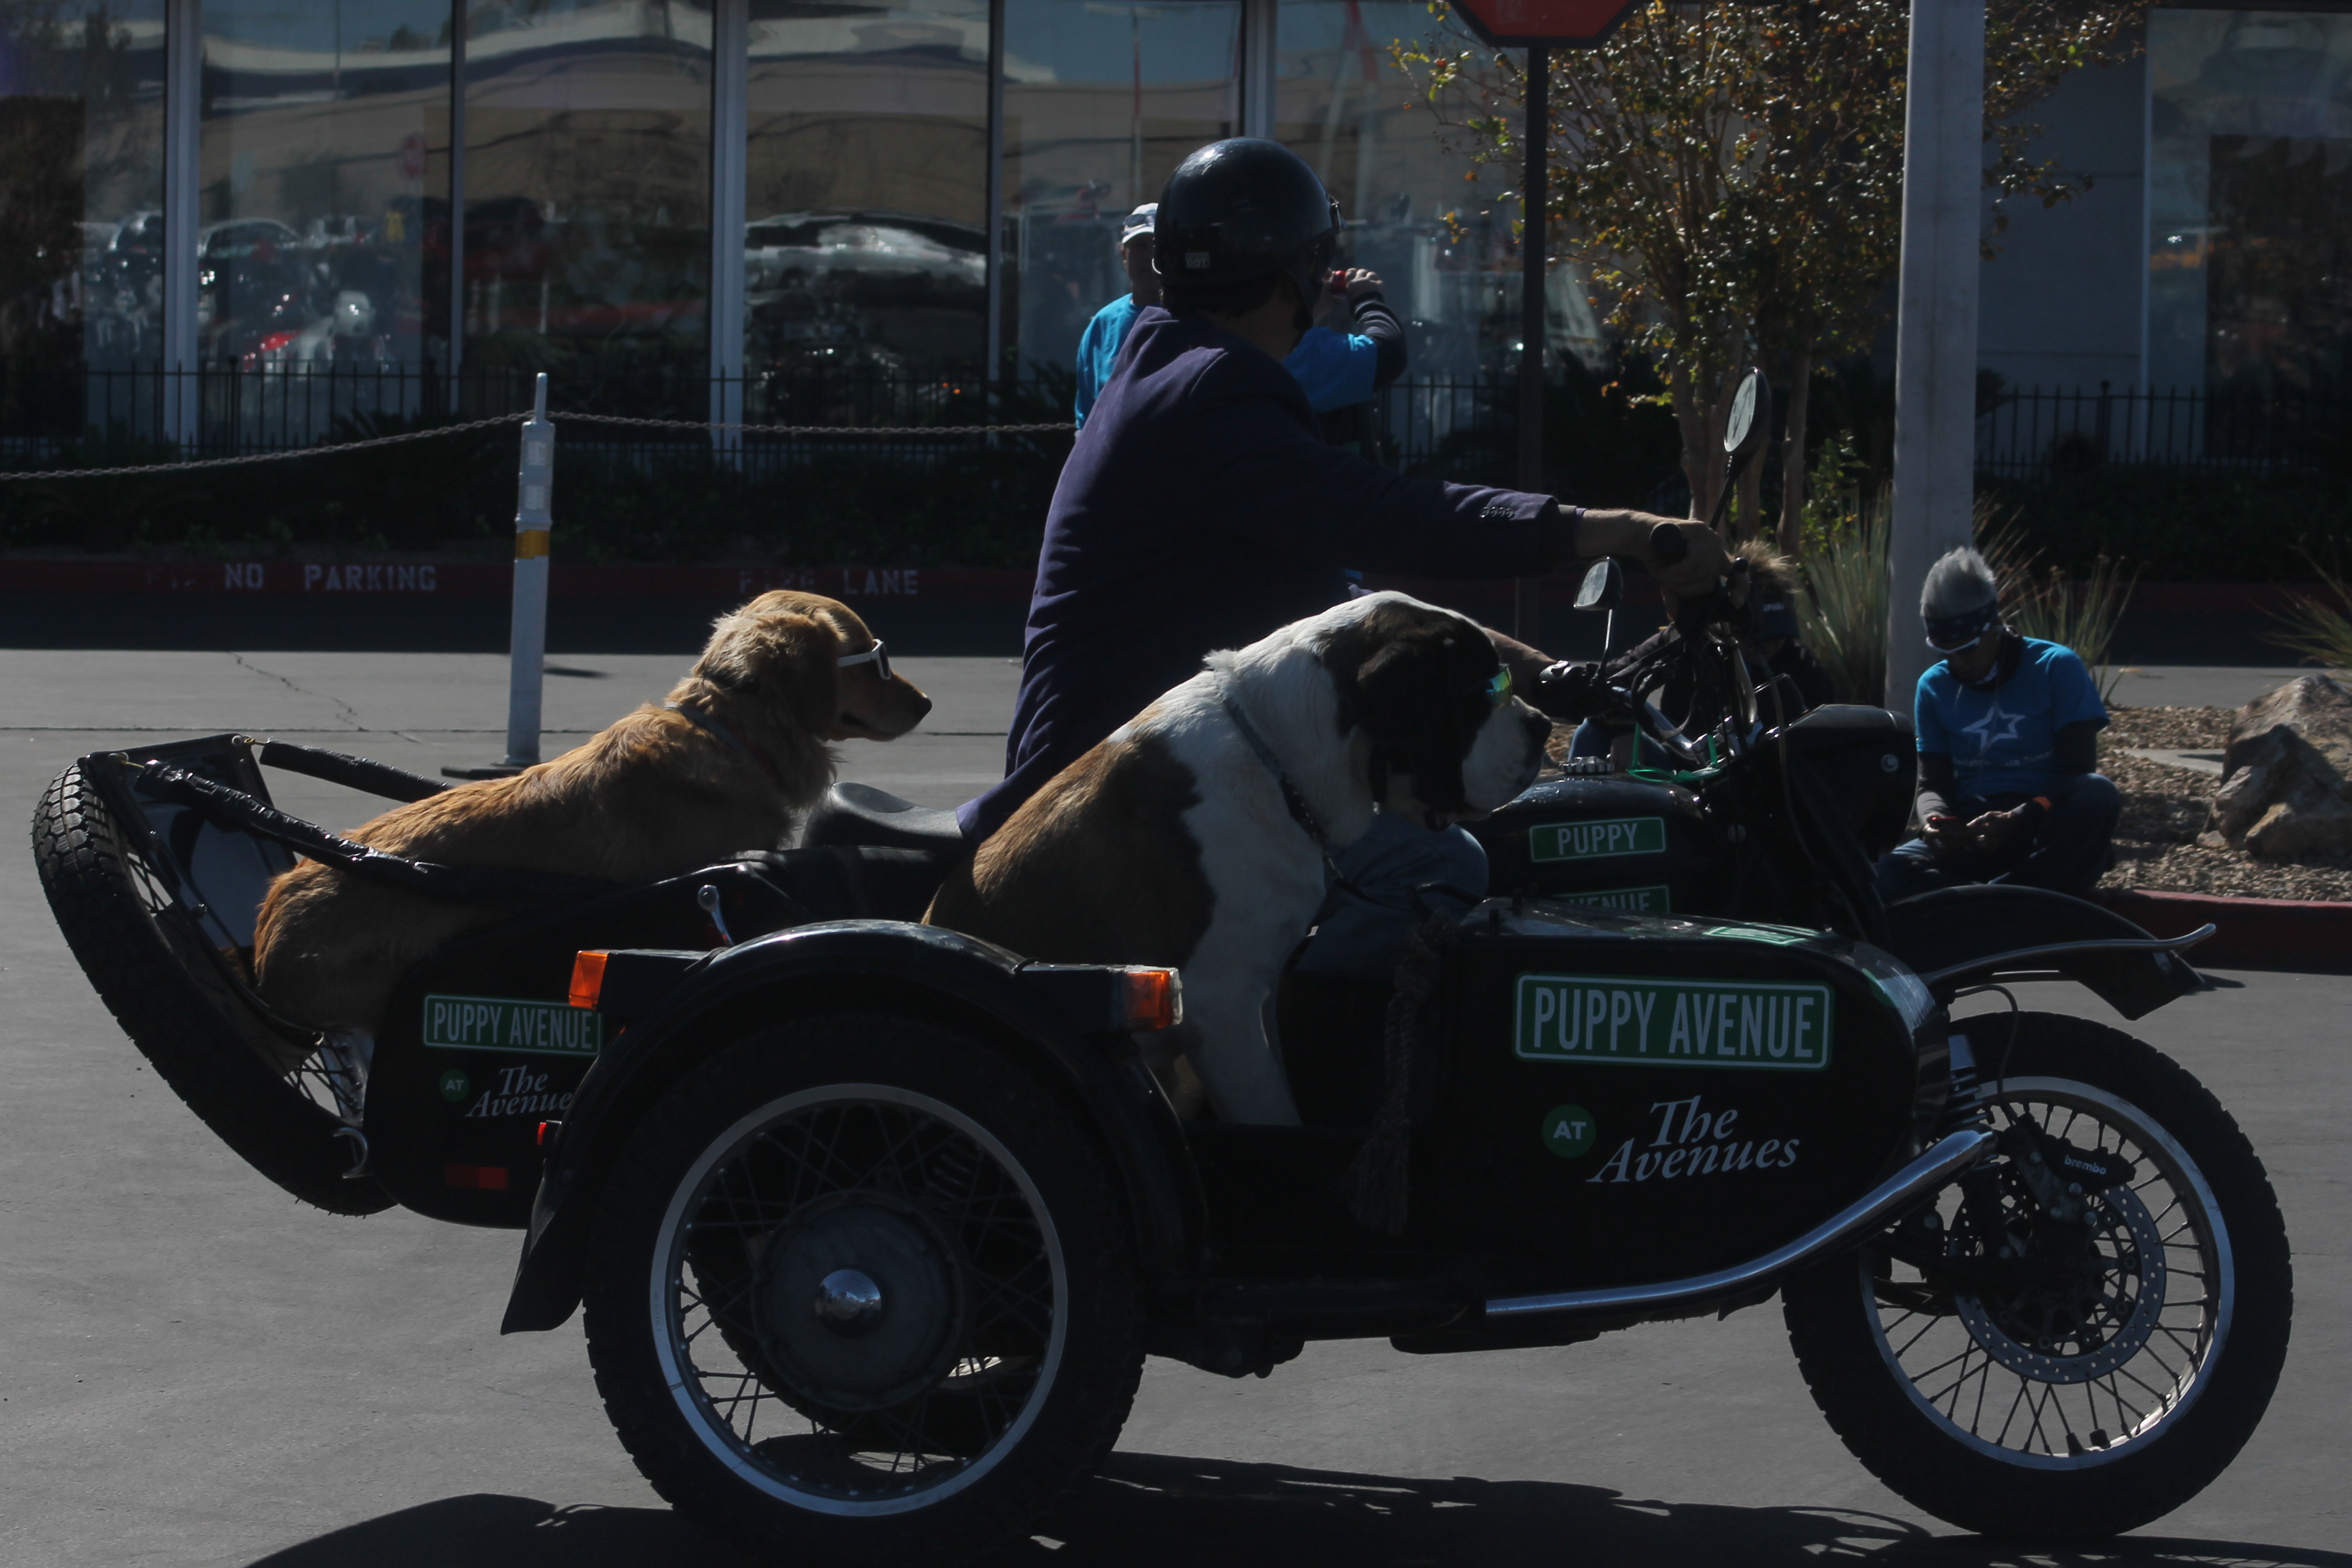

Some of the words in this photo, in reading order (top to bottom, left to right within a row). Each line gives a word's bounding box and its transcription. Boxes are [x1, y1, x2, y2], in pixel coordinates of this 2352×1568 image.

[1188, 258, 1207, 267] DOT
[225, 563, 264, 589] NO
[304, 563, 436, 591] PARKING
[843, 568, 919, 595] LANE
[1557, 823, 1638, 856] PUPPY
[433, 1002, 503, 1043] PUPPY
[509, 1007, 592, 1049] AVENUE
[1533, 986, 1657, 1053] PUPPY
[1668, 993, 1815, 1058] AVENUE
[445, 1079, 464, 1091] AT
[499, 1064, 548, 1096] The
[465, 1089, 573, 1118] Avenue
[1553, 1120, 1587, 1140] AT
[1648, 1095, 1739, 1148] The
[1586, 1137, 1800, 1183] Avenues
[2065, 1155, 2106, 1175] brembo
